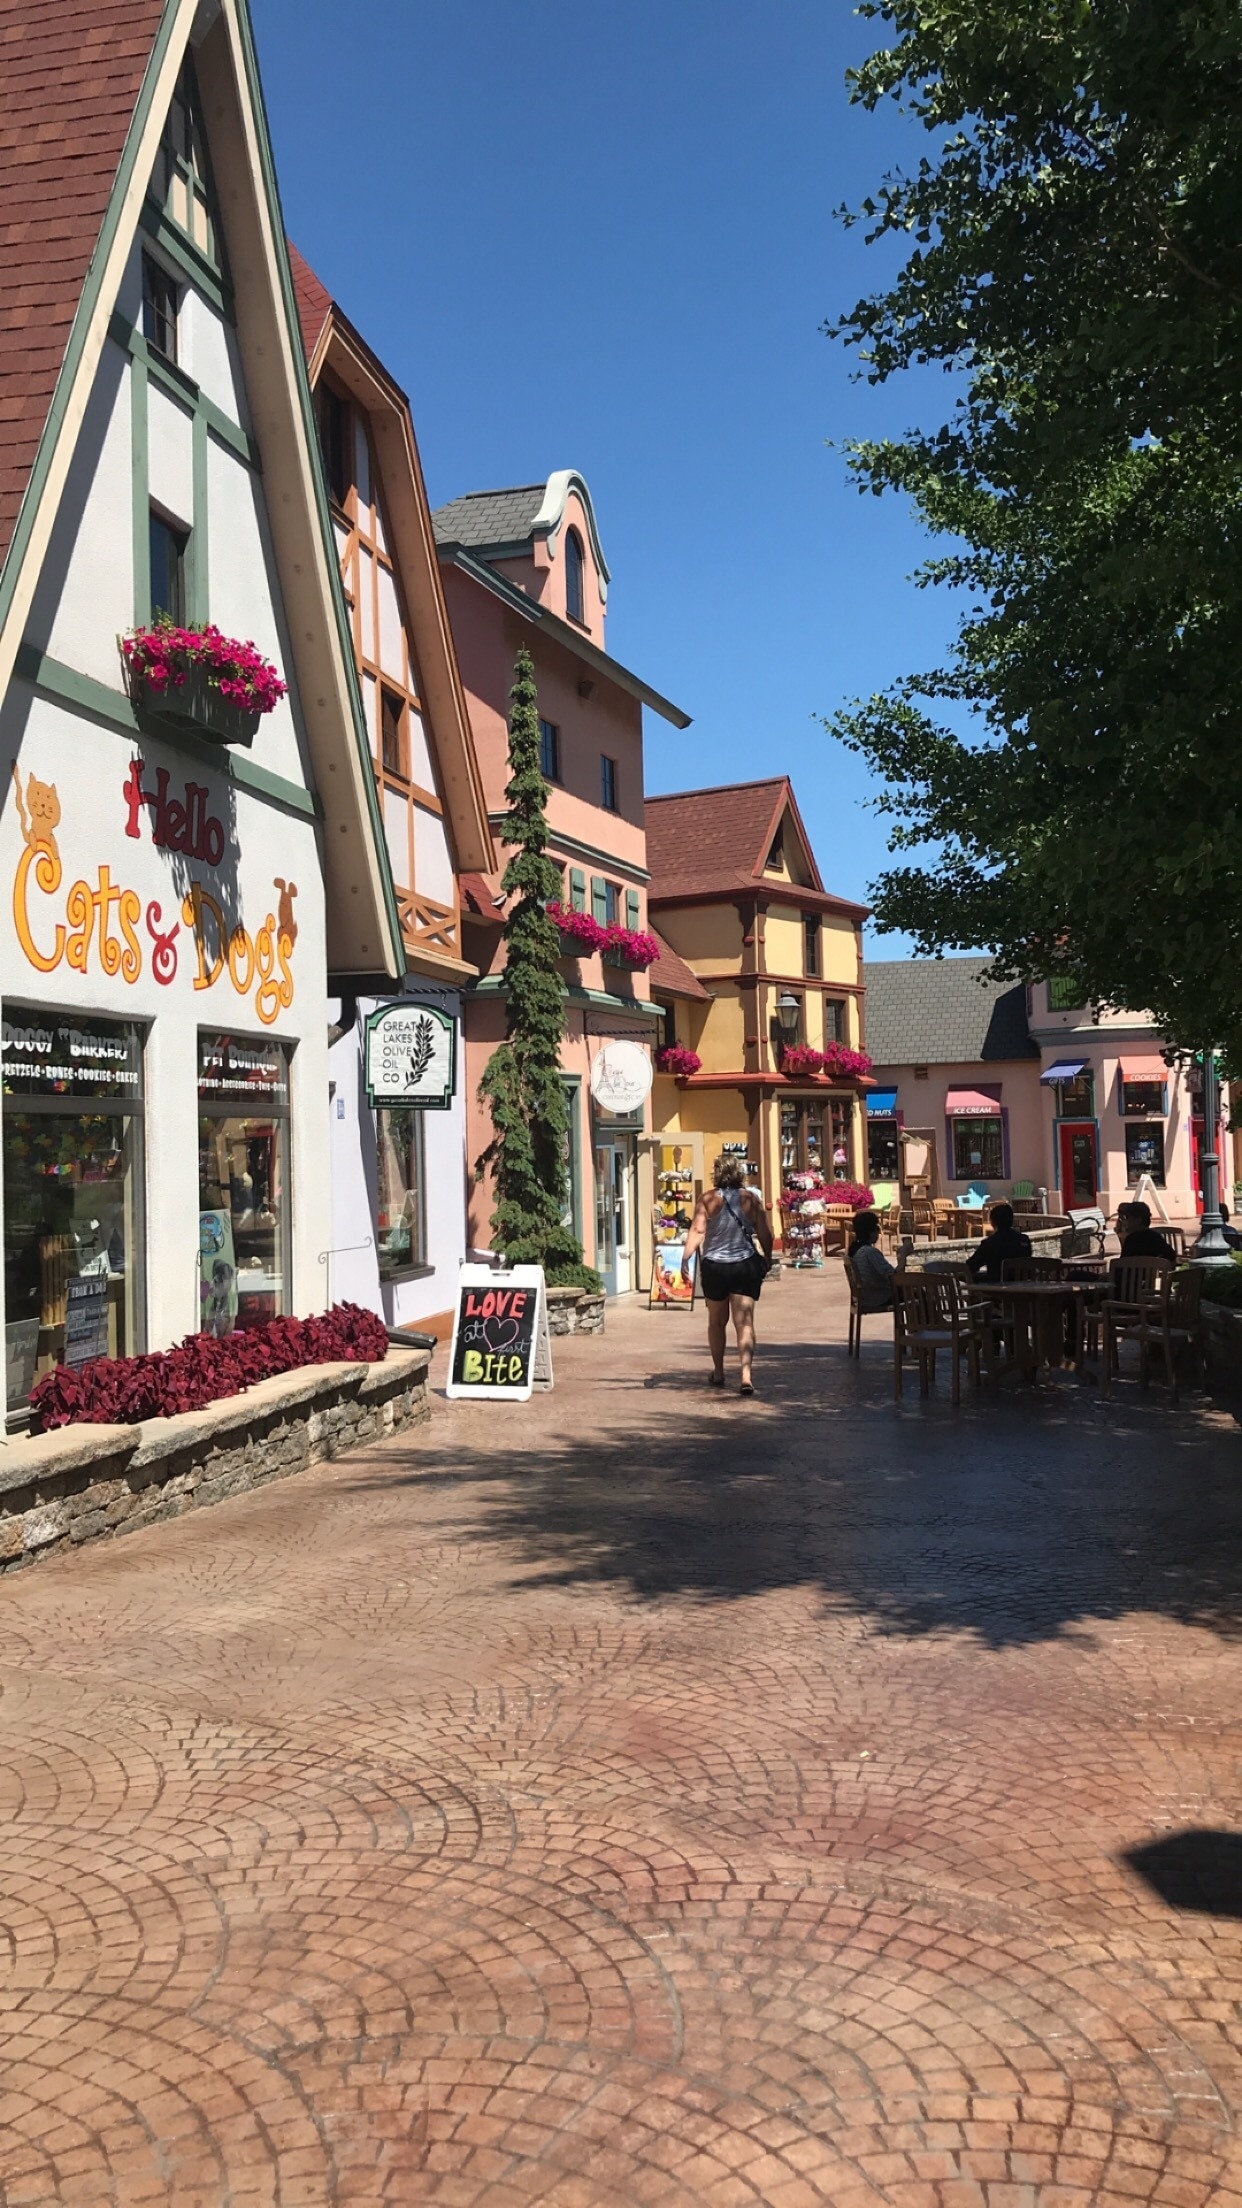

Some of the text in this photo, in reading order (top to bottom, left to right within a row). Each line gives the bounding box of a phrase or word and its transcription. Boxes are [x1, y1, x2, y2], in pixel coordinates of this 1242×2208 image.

[123, 759, 225, 867] Hello
[13, 839, 293, 1025] Cats & Dogs
[383, 1021, 416, 1032] GREAT
[383, 1034, 413, 1043] LAKES
[383, 1046, 412, 1056] OLIVE
[383, 1059, 398, 1068] OIL
[383, 1073, 400, 1083] CO
[465, 1291, 527, 1318] LOVE
[464, 1320, 488, 1343] at
